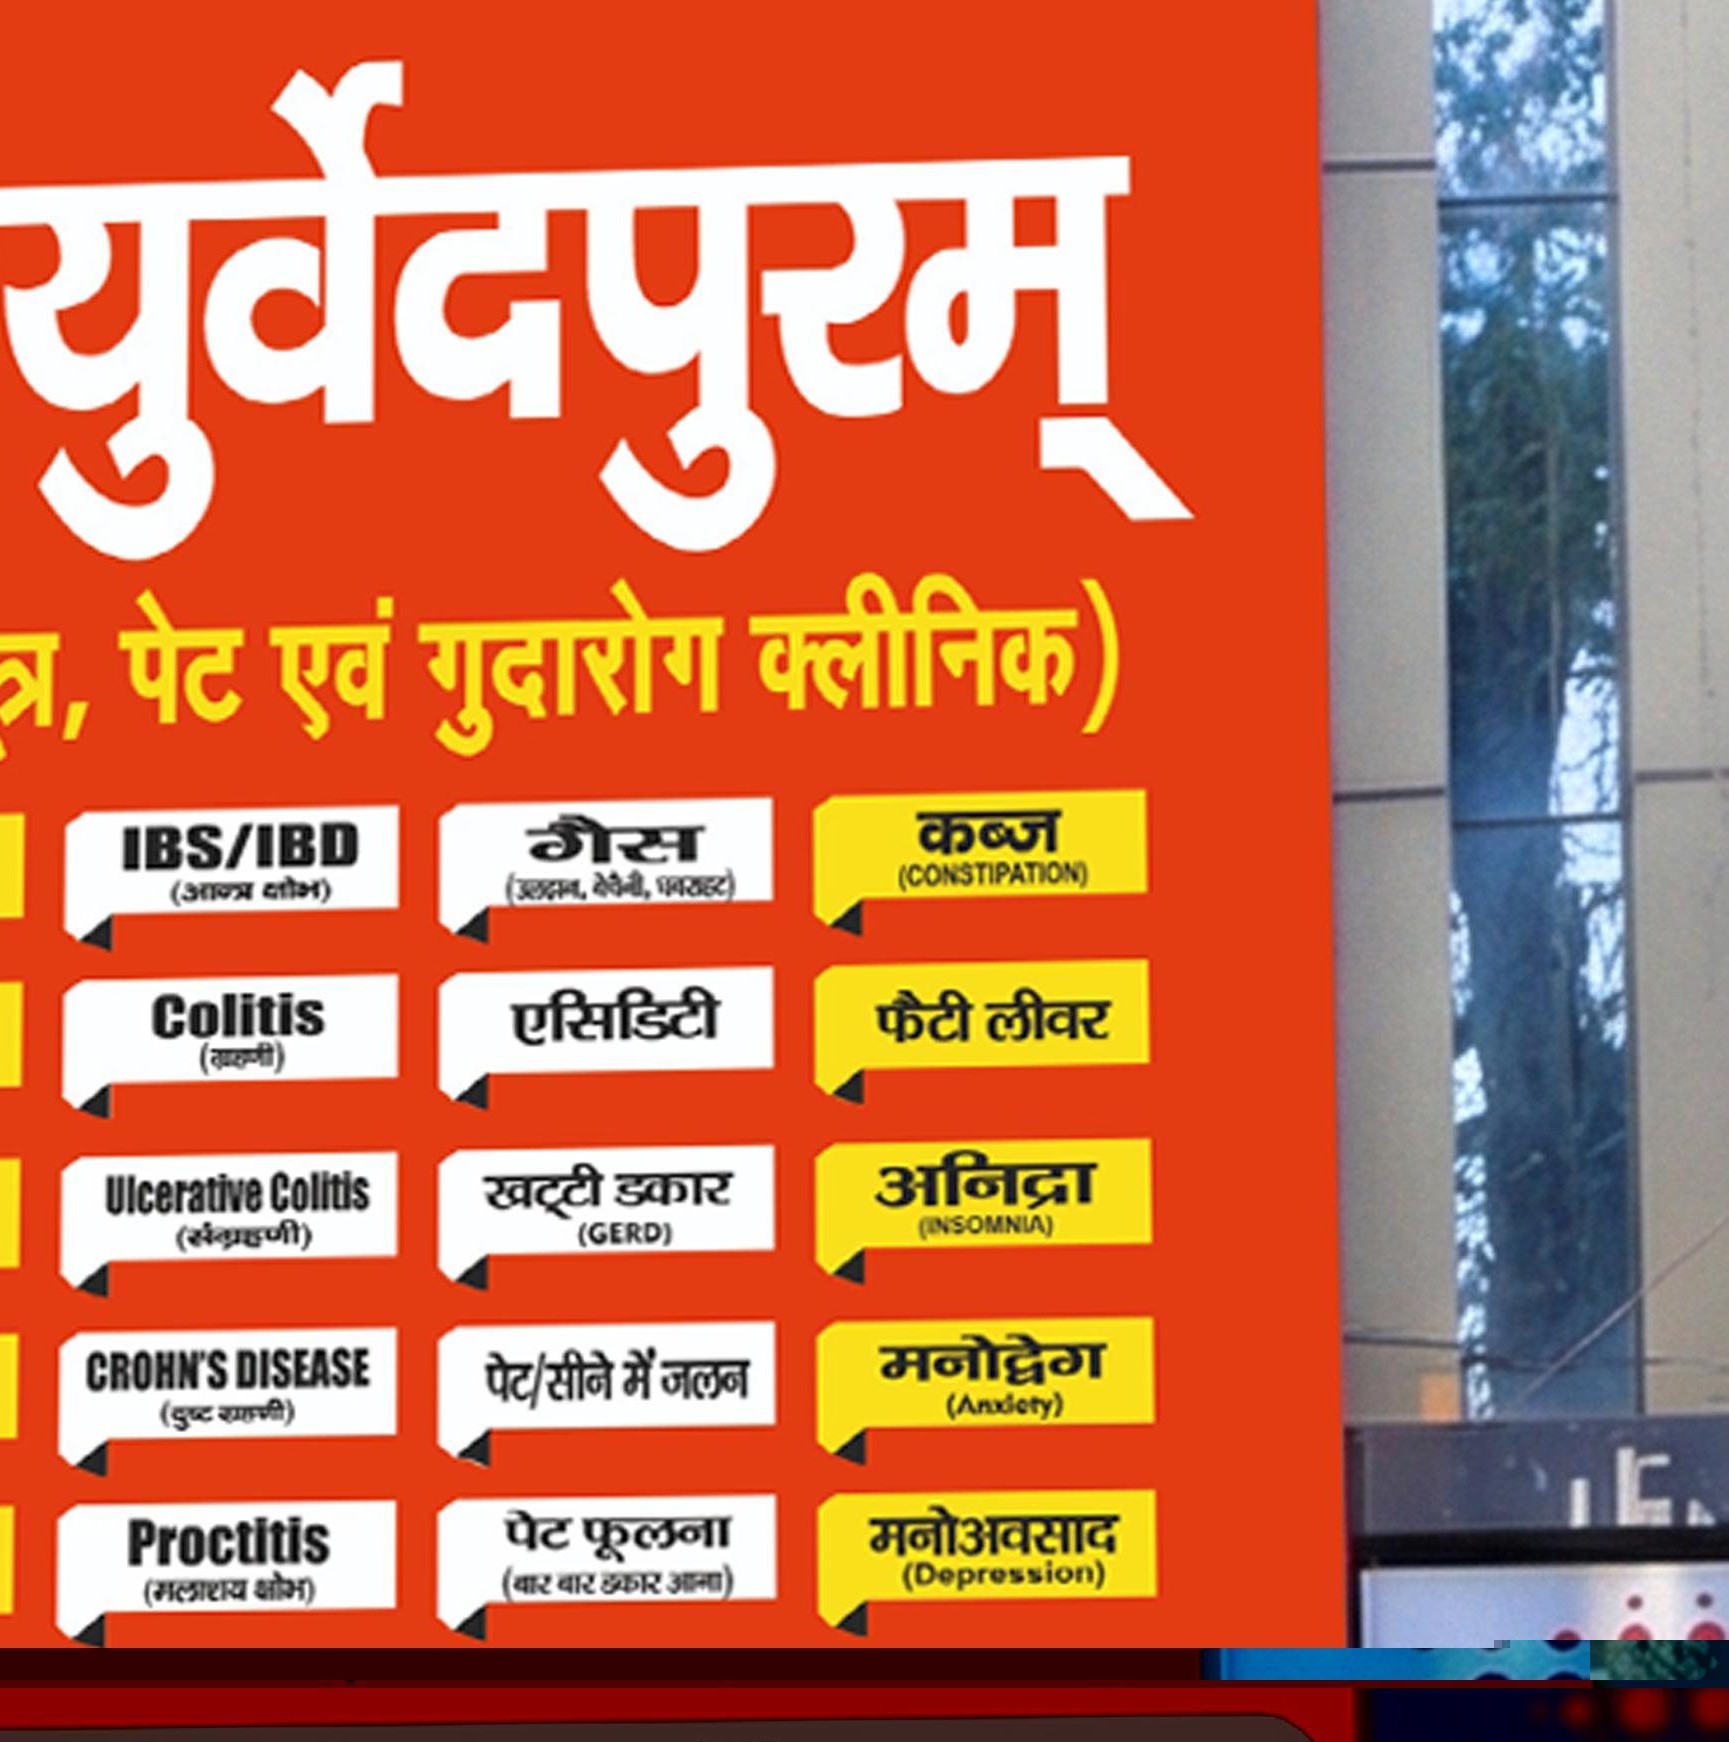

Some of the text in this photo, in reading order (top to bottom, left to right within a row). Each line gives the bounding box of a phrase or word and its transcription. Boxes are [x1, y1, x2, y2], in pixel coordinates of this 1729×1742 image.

[120, 591, 242, 724] पेट
[273, 597, 393, 742] एवं
[420, 579, 724, 756] गुदारोग
[752, 573, 1122, 732] क्लीनिक)
[123, 822, 359, 871] IBS/IBD
[526, 814, 706, 864] गैस
[917, 809, 1062, 854] कब्ज
[899, 861, 1088, 891] (CONSTIPATION)
[152, 993, 324, 1038] Colitis
[511, 985, 721, 1045] एसिडिटी
[875, 987, 1112, 1044] फैटी लीवर
[106, 1171, 370, 1215] Ulcerative Colitis
[614, 1171, 735, 1206] डकार
[874, 1150, 1099, 1208] अनिद्रा
[579, 1222, 672, 1247] (GERD)
[918, 1213, 1053, 1240] (INSOMNIA)
[86, 1347, 370, 1392] CROHN'S DISEASE
[486, 1348, 751, 1409] पेट/सीने में जलन
[879, 1334, 1107, 1385] मनोद्वेग
[946, 1393, 1063, 1419] (Anxiety)
[128, 1516, 330, 1567] Proctitis
[504, 1510, 732, 1564] पेट फूलना
[869, 1506, 1120, 1558] मनोअवसाद
[902, 1561, 1105, 1591] (Depression)
